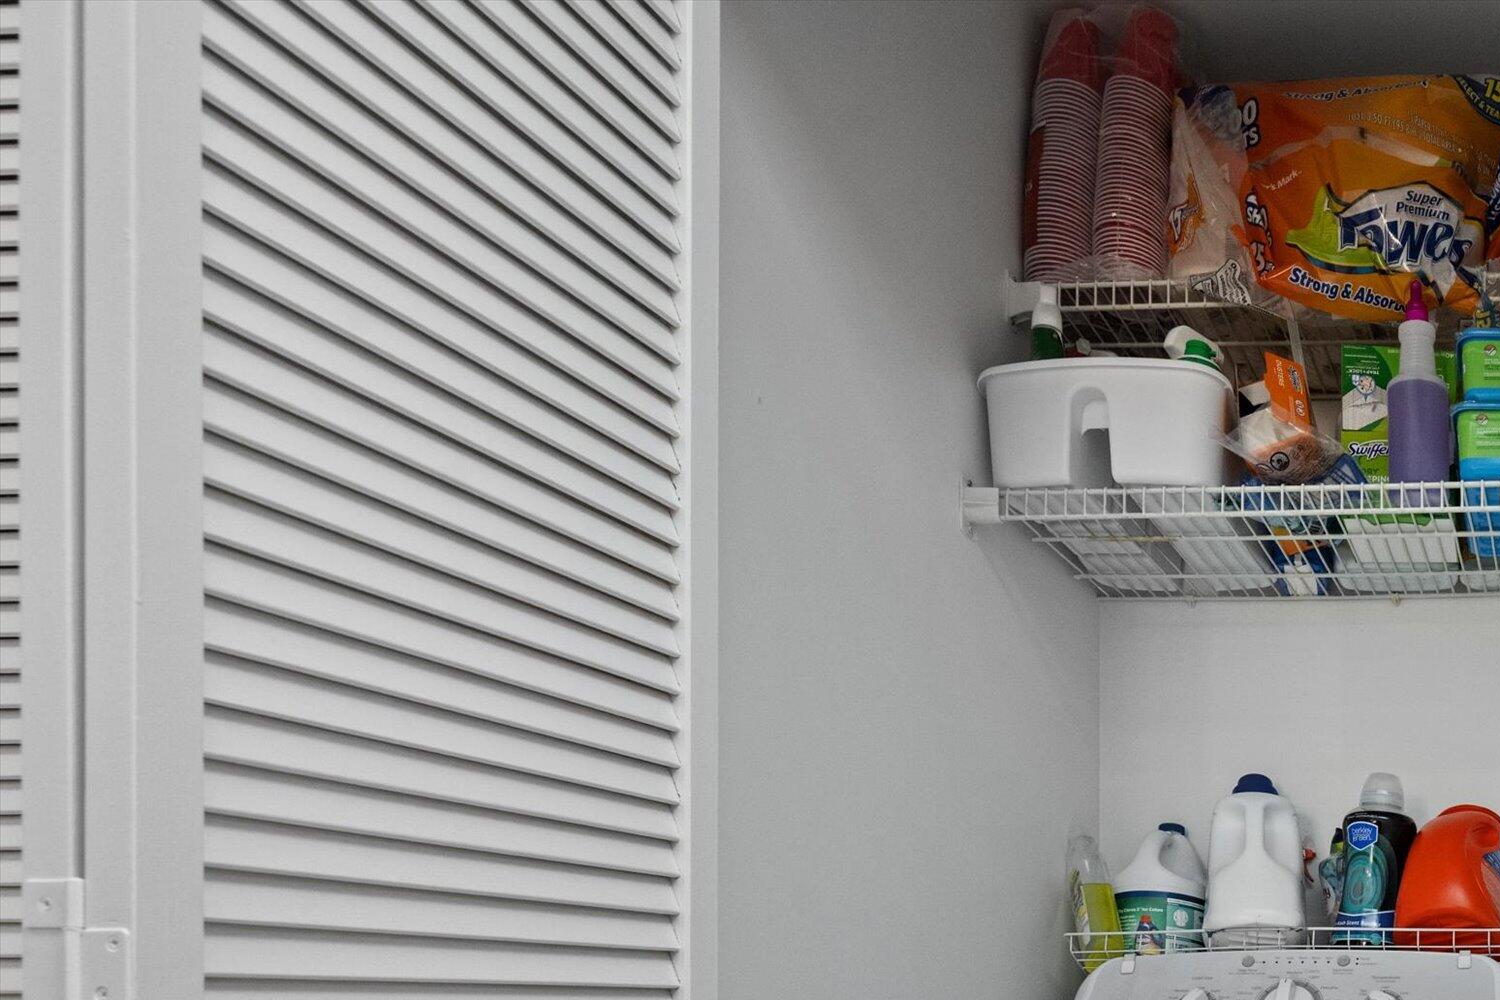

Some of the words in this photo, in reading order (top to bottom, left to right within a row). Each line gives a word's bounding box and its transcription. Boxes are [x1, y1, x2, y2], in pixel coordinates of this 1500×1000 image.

[1405, 190, 1444, 207] Super
[1395, 201, 1450, 221] Premium
[1288, 266, 1340, 299] Strong
[1340, 283, 1353, 300] &
